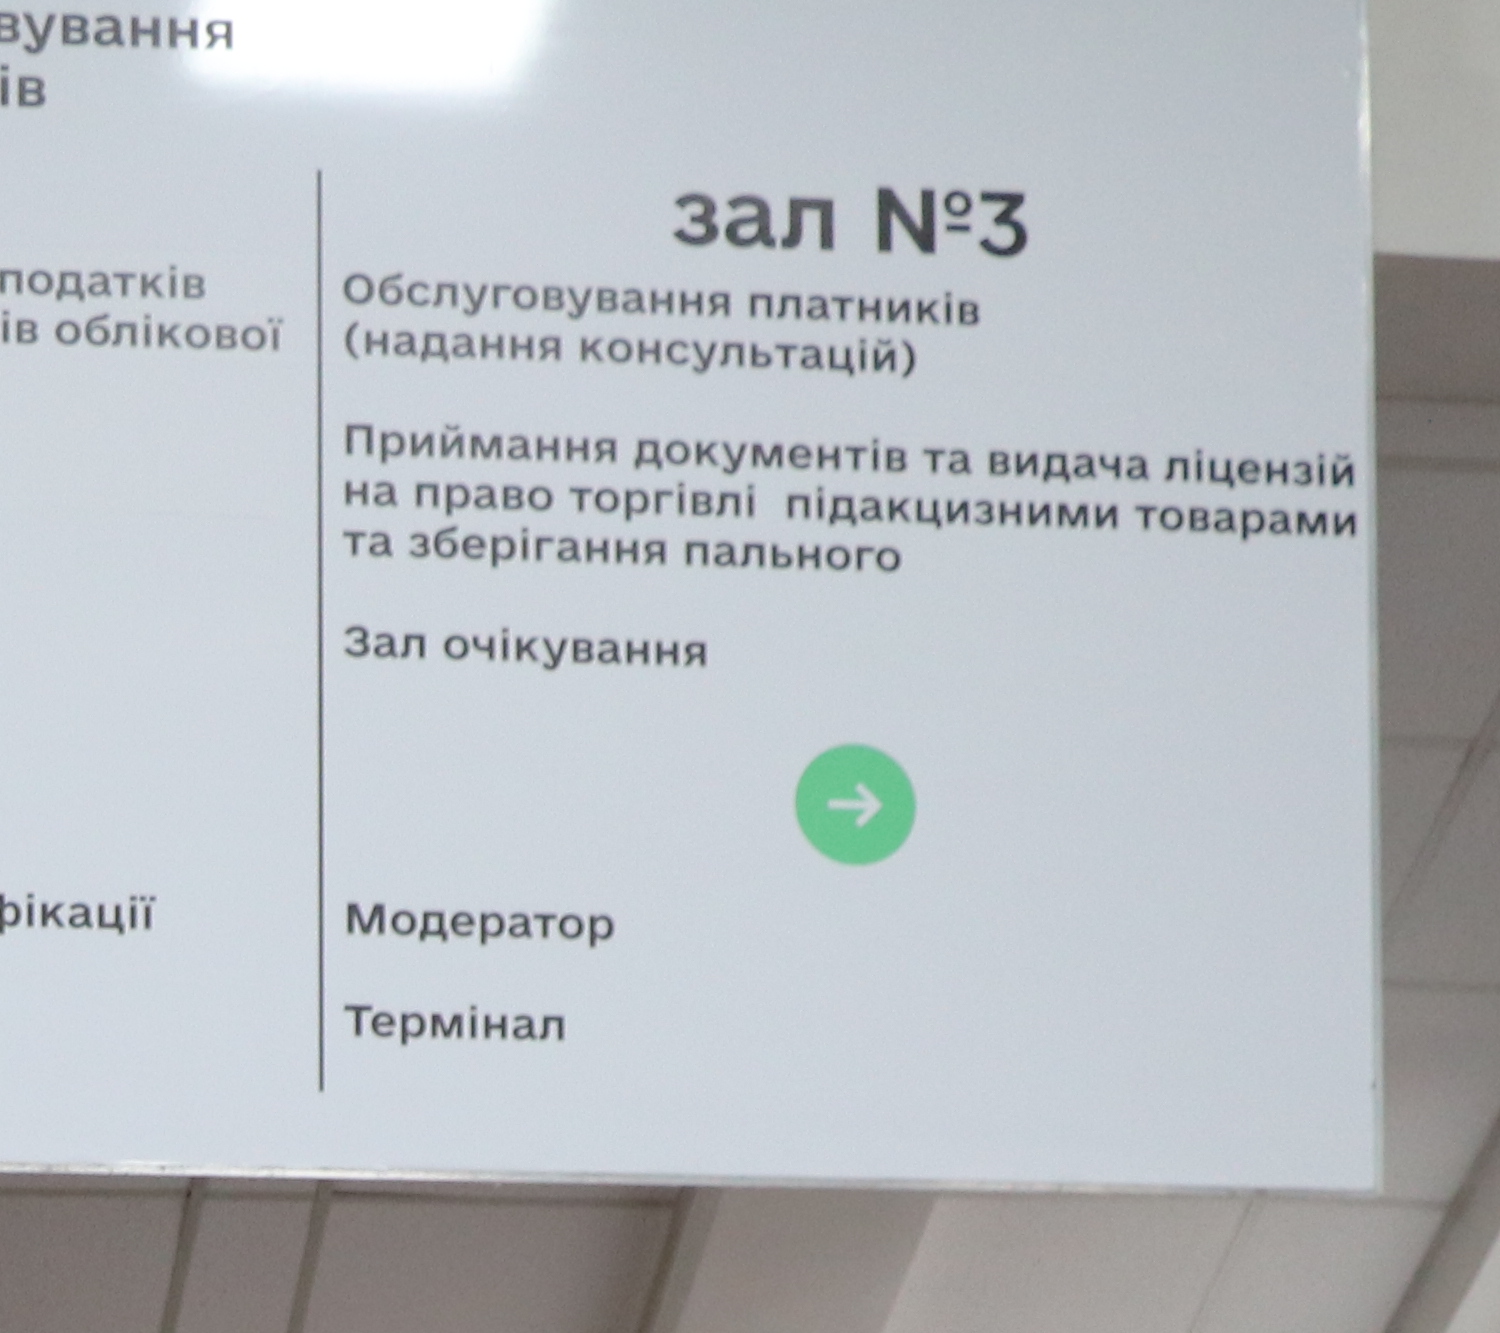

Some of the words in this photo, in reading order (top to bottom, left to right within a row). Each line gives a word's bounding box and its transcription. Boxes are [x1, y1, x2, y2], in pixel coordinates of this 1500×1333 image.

[673, 192, 834, 251] зал
[877, 186, 1028, 259] №3
[0, 265, 205, 302] податків
[343, 273, 731, 320] Обслуговування
[749, 291, 980, 327] платників
[55, 313, 283, 351] облікової
[345, 321, 561, 363] (надання
[580, 337, 916, 379] консультацій)
[345, 423, 617, 465] Приймання
[633, 438, 908, 476] документів
[923, 448, 972, 475] та
[988, 450, 1149, 484] видача
[1164, 448, 1355, 489] ліцензій
[344, 480, 398, 507] на
[415, 482, 554, 517] право
[569, 481, 755, 522] торгівлі
[787, 486, 1118, 530] підакцизними
[1135, 505, 1357, 542] товарами
[343, 530, 393, 557] та
[409, 525, 667, 569] зберігання
[685, 540, 902, 573] пального
[344, 625, 426, 659] Зал
[443, 627, 707, 671] очікування
[346, 902, 615, 949] Модератор
[344, 1004, 565, 1046] Термінал
